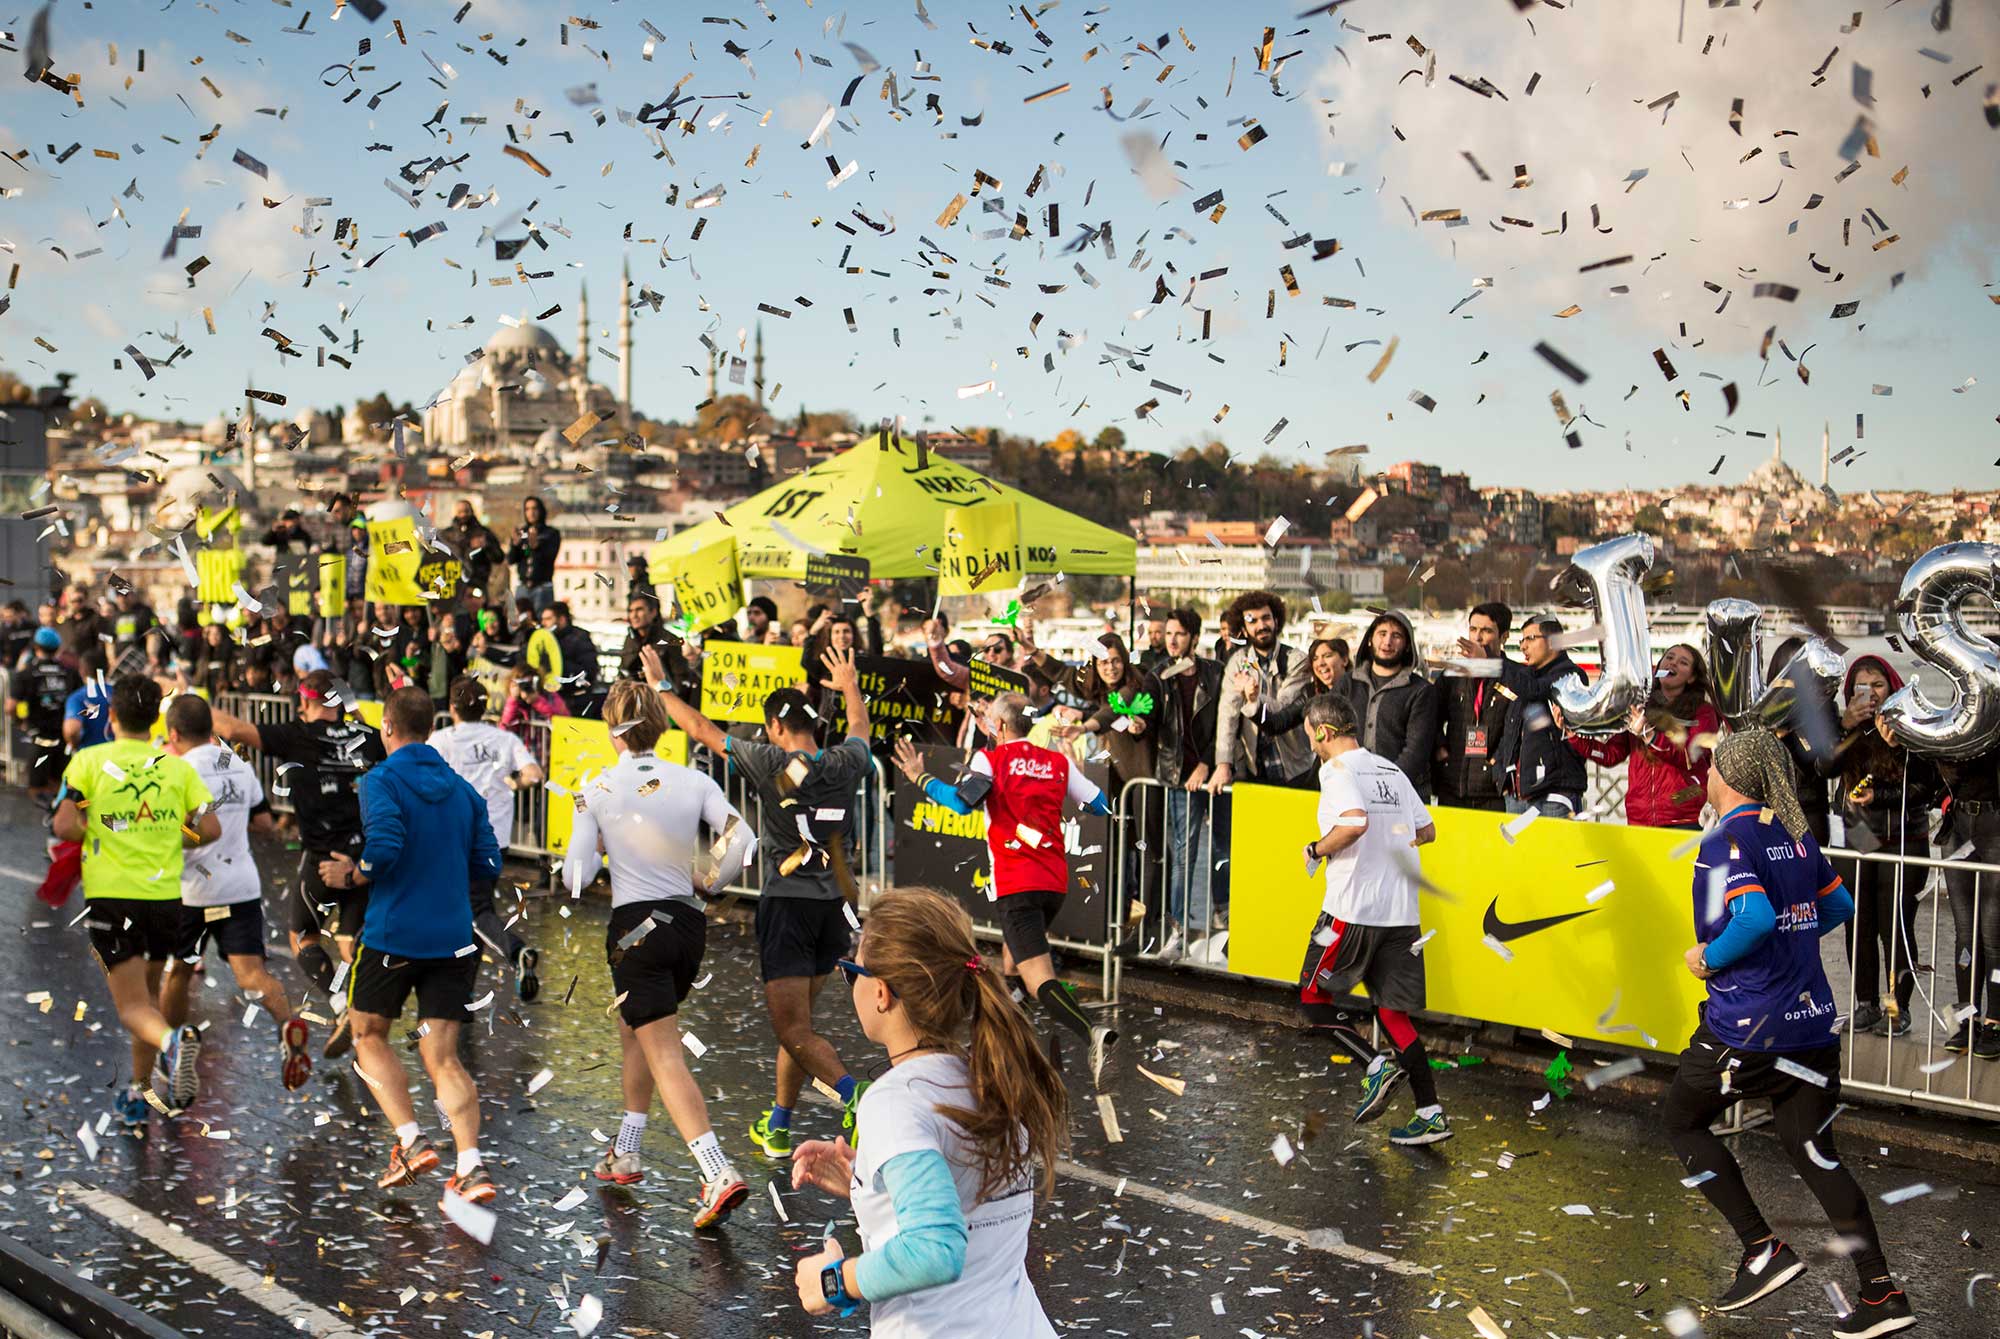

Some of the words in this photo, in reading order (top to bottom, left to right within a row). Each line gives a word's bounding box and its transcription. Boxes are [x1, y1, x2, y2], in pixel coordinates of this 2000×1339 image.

[914, 476, 977, 494] NRC
[712, 652, 746, 668] SON
[712, 671, 798, 690] MRATON
[839, 695, 925, 721] YINDAN
[1766, 842, 1795, 861] ODTÜ
